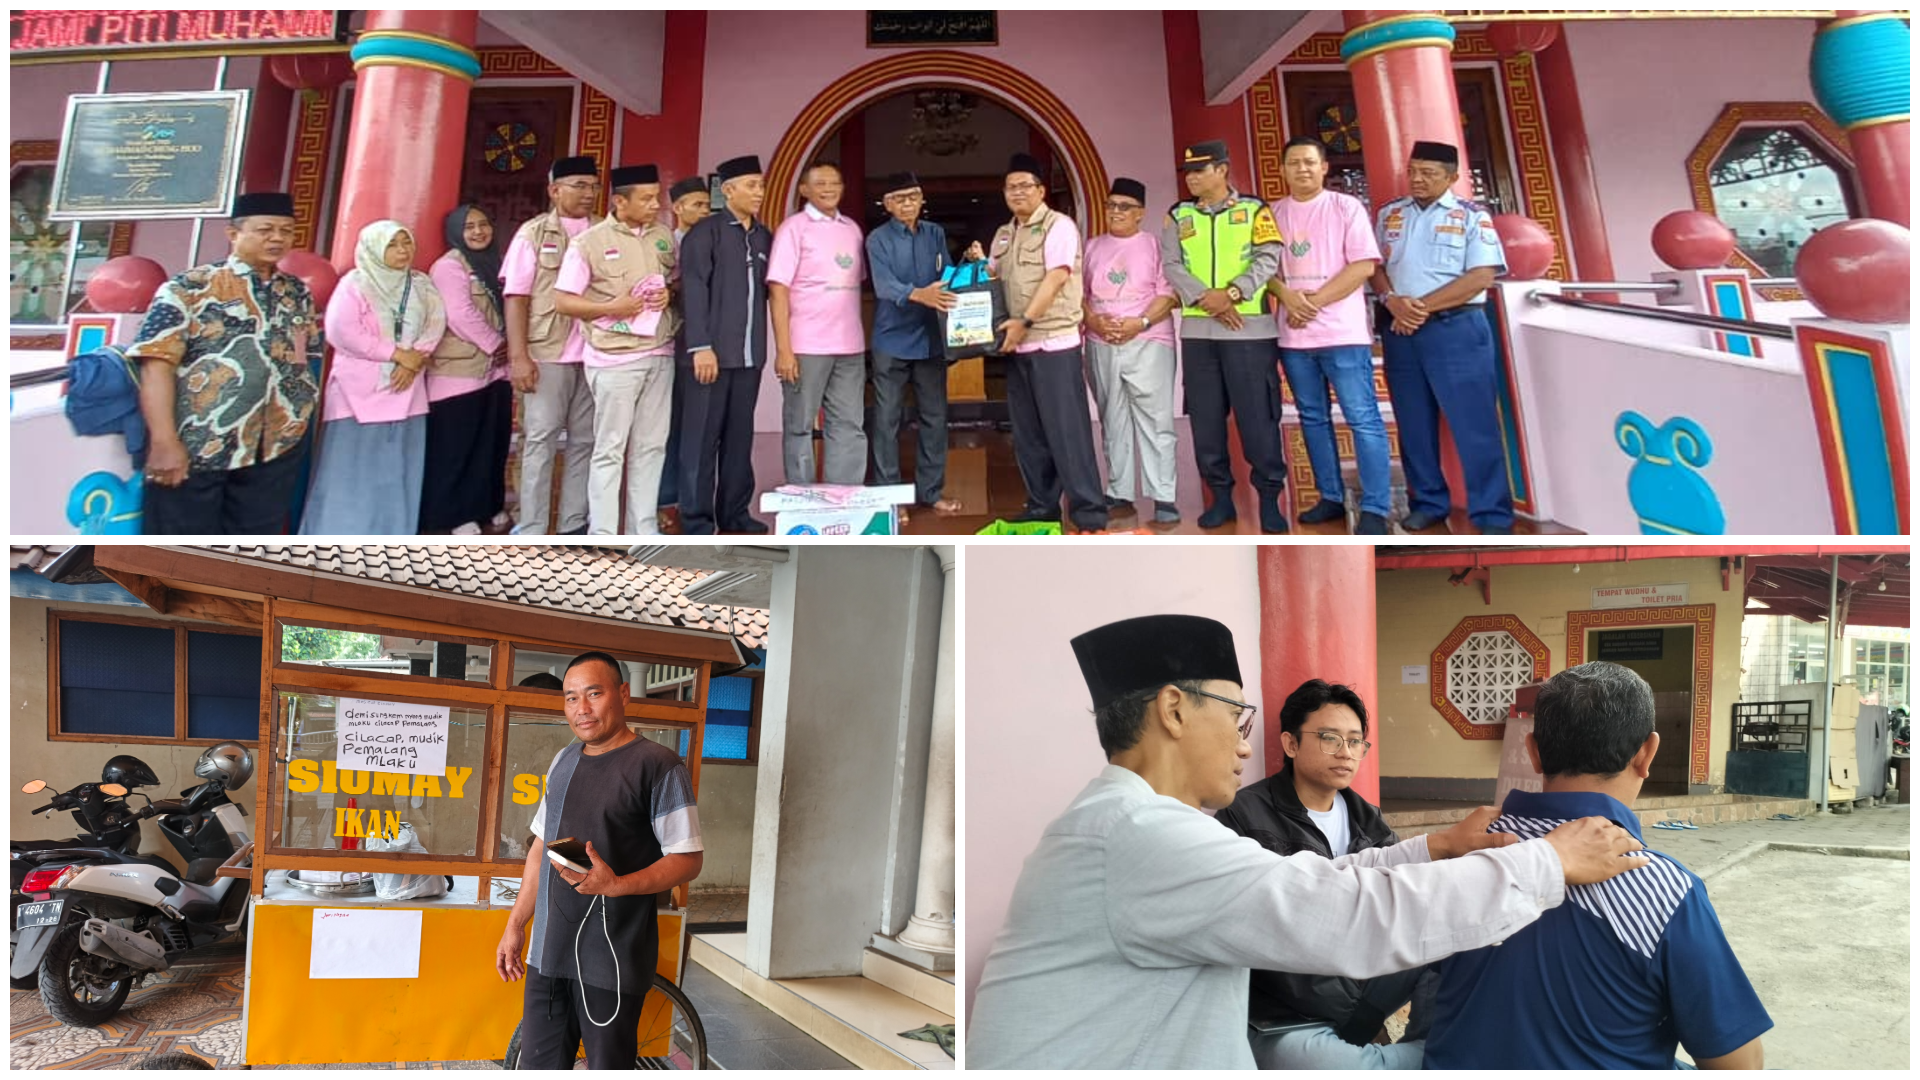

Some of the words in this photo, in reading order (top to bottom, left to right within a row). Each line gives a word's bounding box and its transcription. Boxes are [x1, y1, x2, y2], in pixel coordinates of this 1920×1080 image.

[100, 14, 169, 44] PITI
[1597, 588, 1622, 597] TEMPAT
[1624, 587, 1650, 596] WUDHU
[1651, 586, 1656, 594] &
[1641, 595, 1664, 604] TOILET
[1666, 594, 1683, 603] PRIA
[288, 758, 473, 799] SIUMAY
[333, 807, 402, 840] IKAN
[25, 904, 45, 915] 4604
